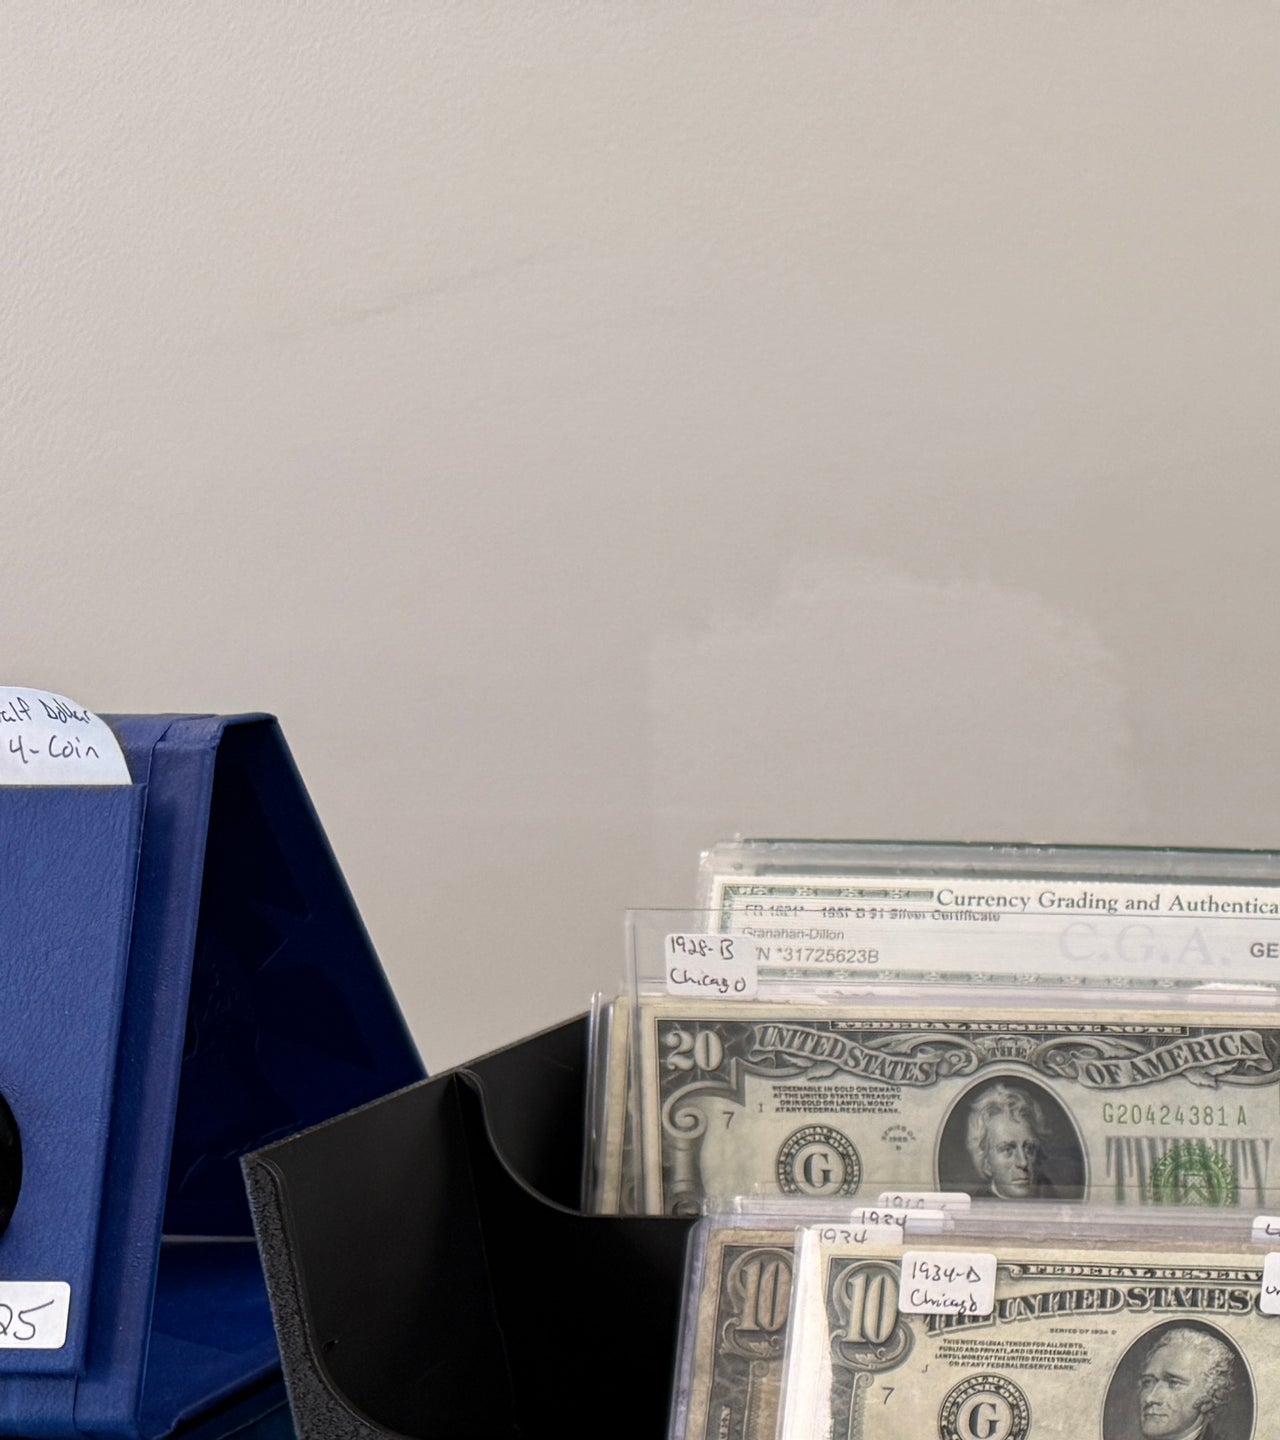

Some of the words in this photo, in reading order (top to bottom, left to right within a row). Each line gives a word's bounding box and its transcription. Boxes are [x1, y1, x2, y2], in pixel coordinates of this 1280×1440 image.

[936, 888, 1032, 911] Currency
[1038, 890, 1119, 914] Grading
[1124, 893, 1160, 911] and
[670, 967, 747, 994] Chicago
[665, 1030, 725, 1072] 20
[756, 1026, 850, 1060] UNITED
[846, 1048, 936, 1083] STATES
[1085, 1063, 1119, 1086] OF
[1120, 1034, 1261, 1083] AMERICA
[722, 1112, 735, 1130] 7
[1103, 1104, 1226, 1127] G20424381
[1237, 1105, 1248, 1127] A
[803, 1153, 831, 1189] G
[1030, 1265, 1150, 1277] FEDERAL
[847, 1273, 899, 1345] 10
[1000, 1285, 1126, 1323] UNITED
[1126, 1286, 1253, 1315] STATES
[882, 1388, 895, 1405] 7
[968, 1401, 1000, 1440] G
